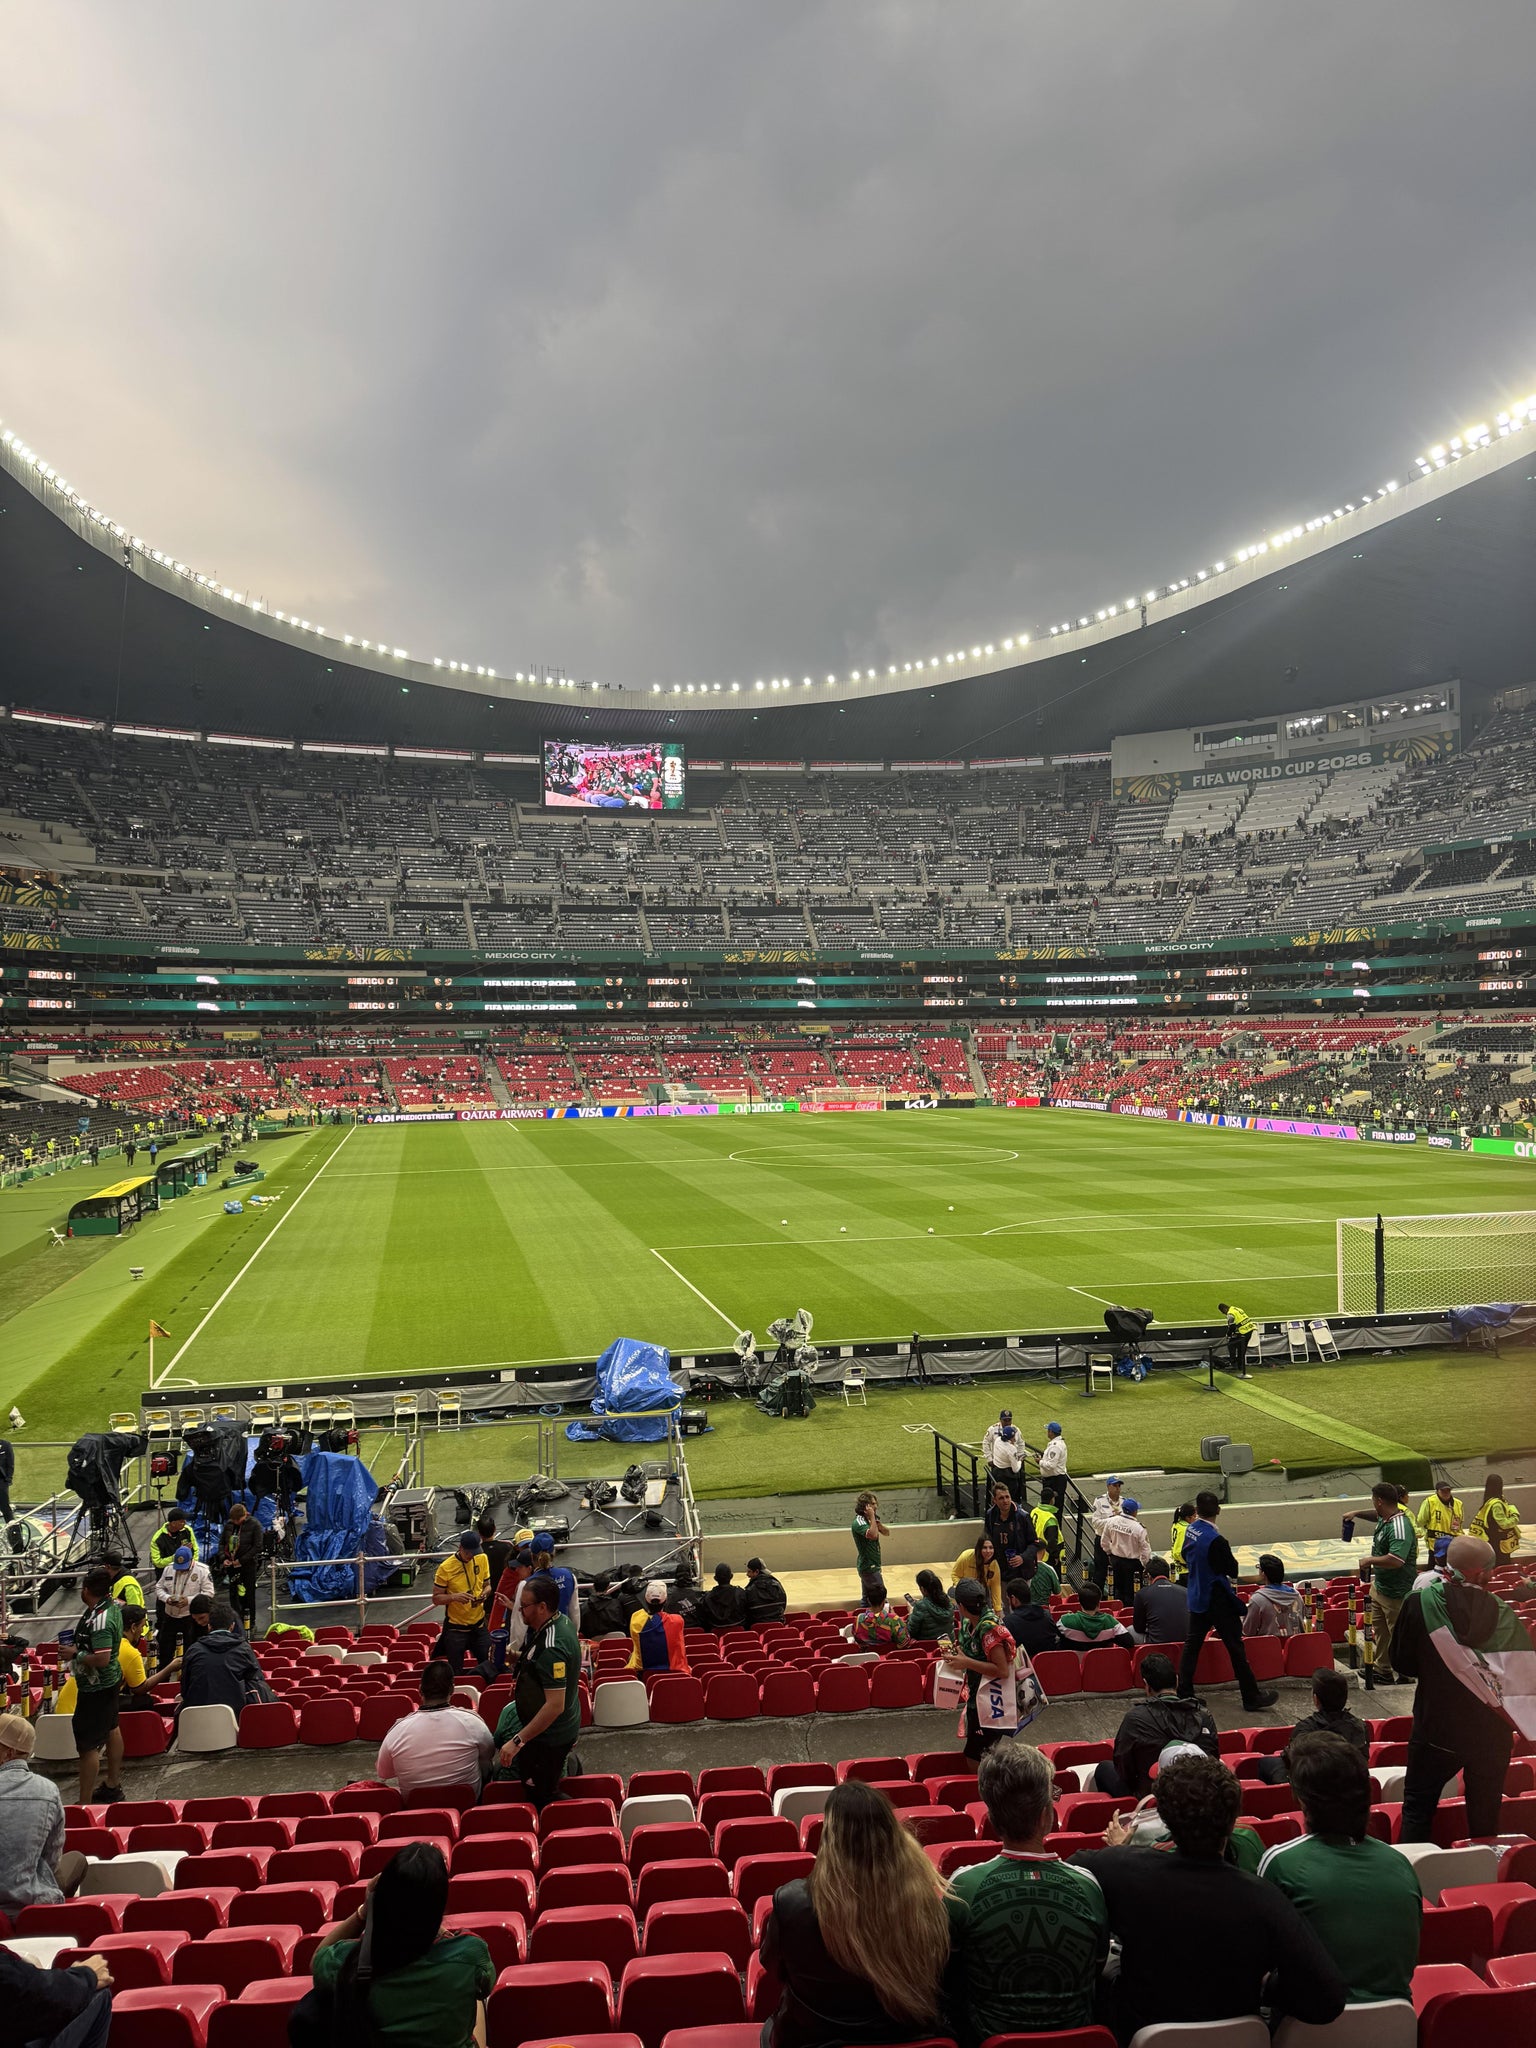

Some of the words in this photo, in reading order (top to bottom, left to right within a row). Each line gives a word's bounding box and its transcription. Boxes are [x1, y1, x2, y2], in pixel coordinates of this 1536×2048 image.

[1192, 773, 1224, 787] FIFA
[1226, 766, 1282, 783] WORLD
[1285, 760, 1315, 776] CUP
[1317, 752, 1372, 772] 2026
[1465, 917, 1501, 927] #FIFAWorldCup
[161, 946, 200, 955] #FIFAWorldCup
[1145, 943, 1188, 953] MEXICO
[1189, 942, 1214, 950] CITY
[1478, 950, 1513, 961] MEXICO
[28, 970, 63, 980] MEXICO
[1206, 968, 1239, 977] MEXICO
[348, 977, 384, 985] MEXICO
[1479, 981, 1514, 991] MEXICO
[1207, 993, 1239, 1001] MEXICO
[28, 999, 62, 1009] MEXICO
[349, 1002, 385, 1010] MEXICO
[1055, 1099, 1071, 1107] ADI
[461, 1110, 497, 1120] QATAR
[500, 1109, 544, 1119] AIRWAYS
[577, 1107, 604, 1117] VISA
[1120, 1104, 1140, 1115] QATAR
[1141, 1106, 1168, 1119] AIRWAYS
[374, 1114, 395, 1123] ADI
[1190, 1112, 1208, 1125] VISA
[1223, 1115, 1243, 1128] VISA
[1372, 1131, 1386, 1140] FIFA
[989, 1677, 1005, 1719] VISA
